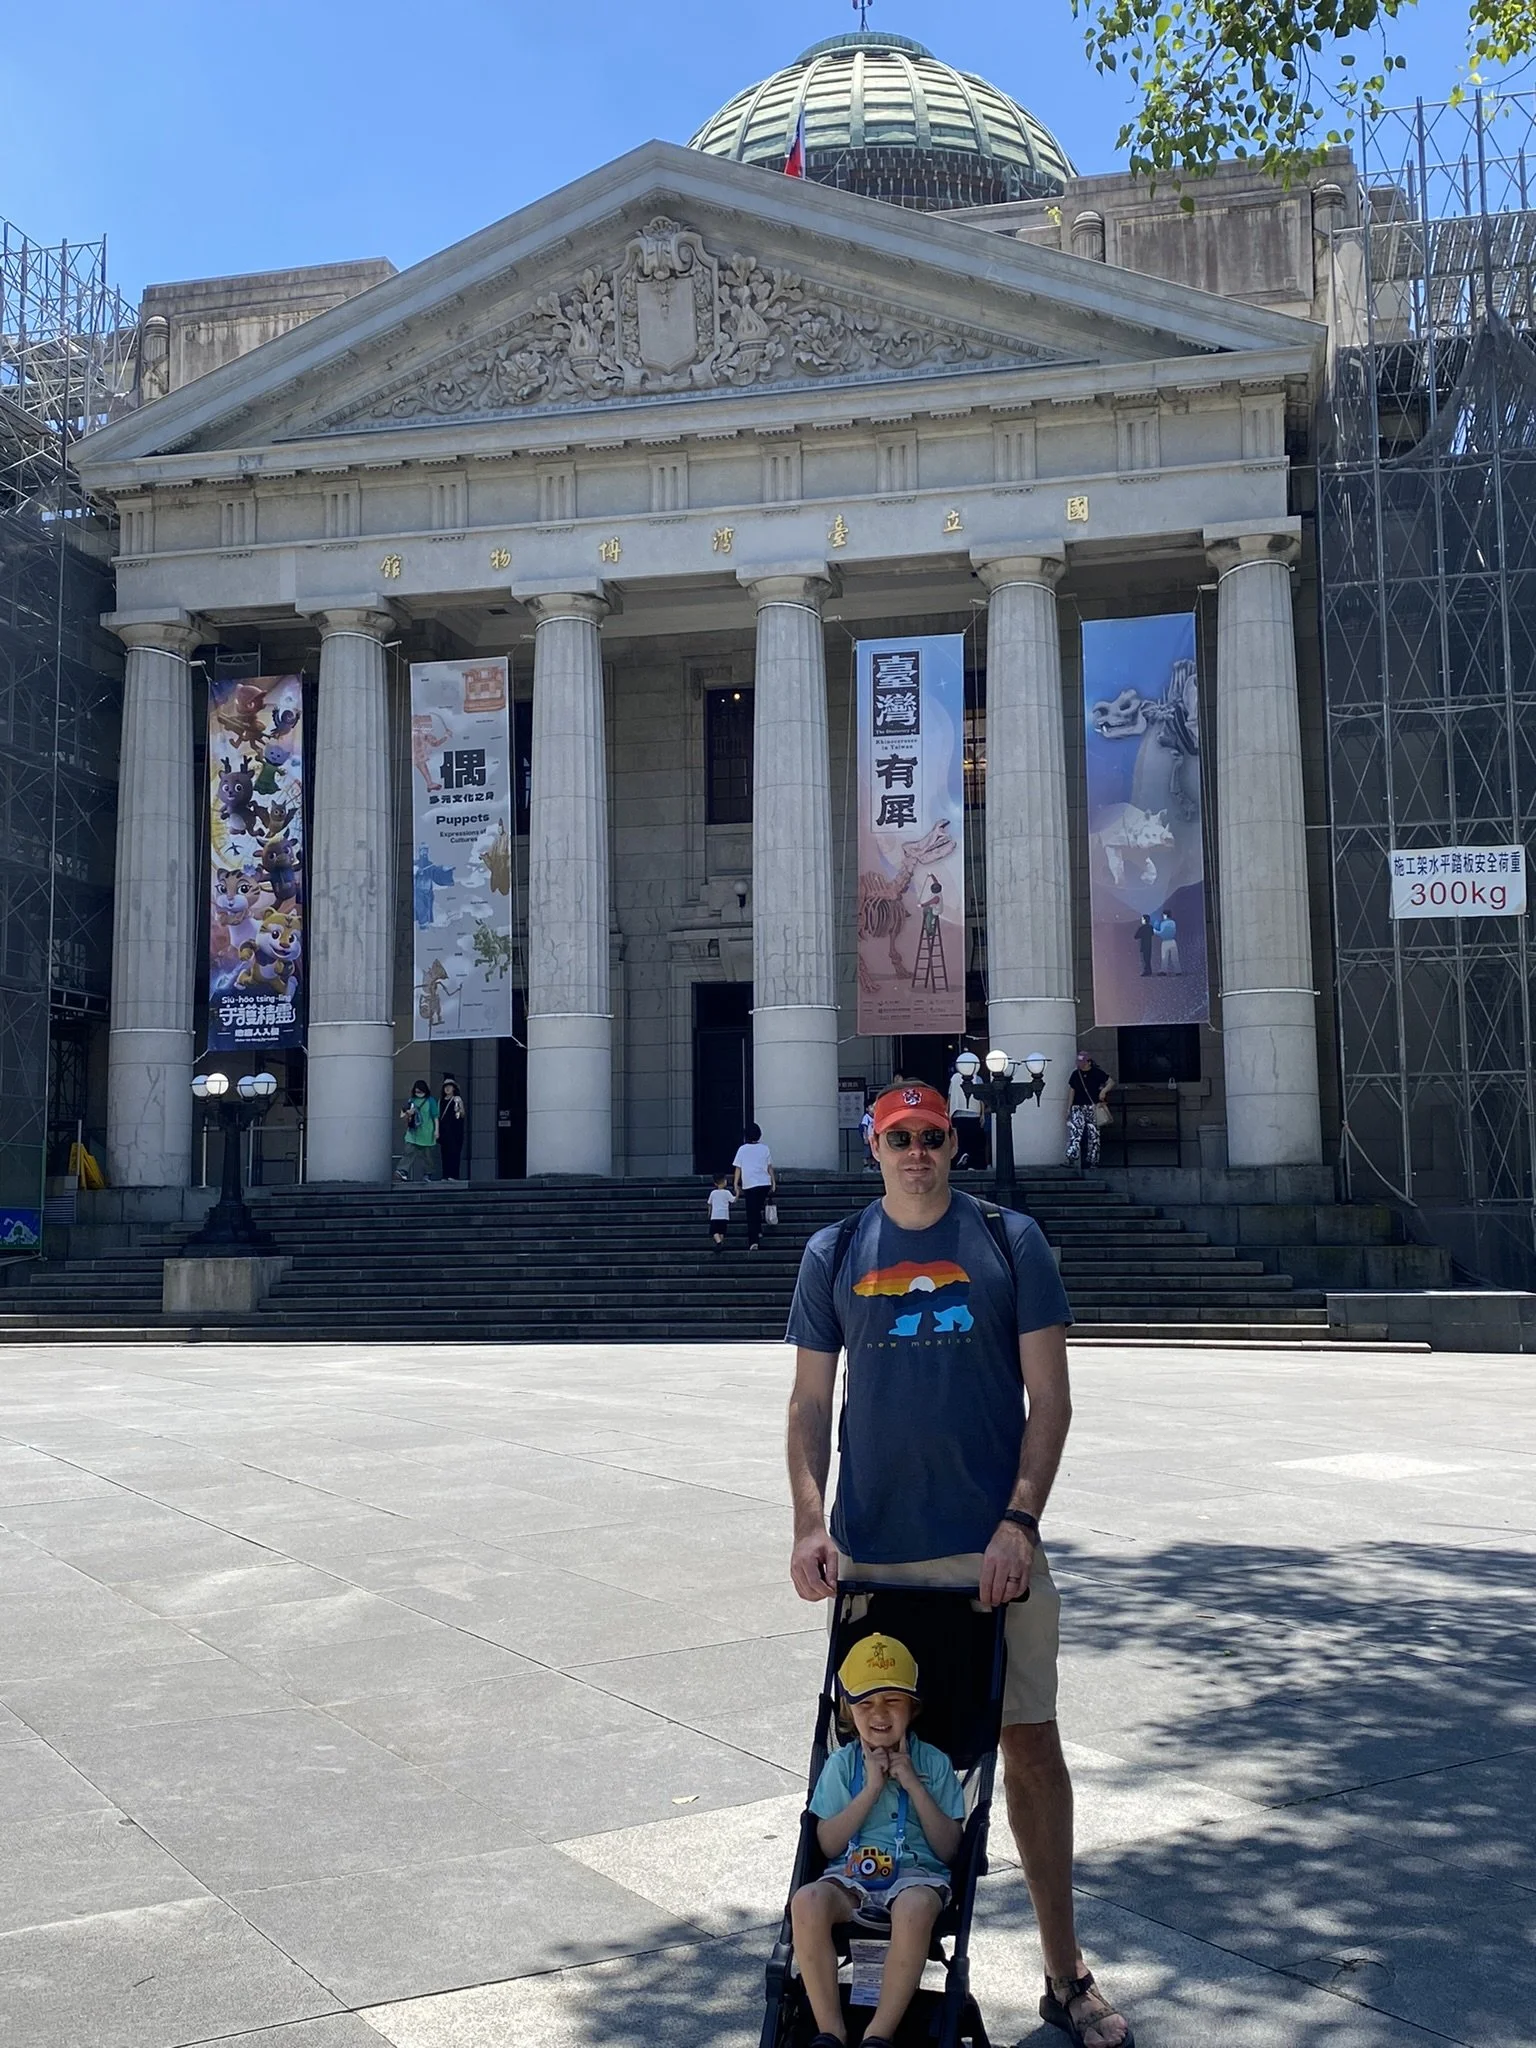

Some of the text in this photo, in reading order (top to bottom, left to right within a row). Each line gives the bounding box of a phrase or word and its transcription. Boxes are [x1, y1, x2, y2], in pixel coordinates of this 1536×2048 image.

[436, 814, 490, 827] Puppets
[1393, 850, 1522, 877] 施工架水平踏板安全荷重
[1410, 881, 1506, 910] 300kg
